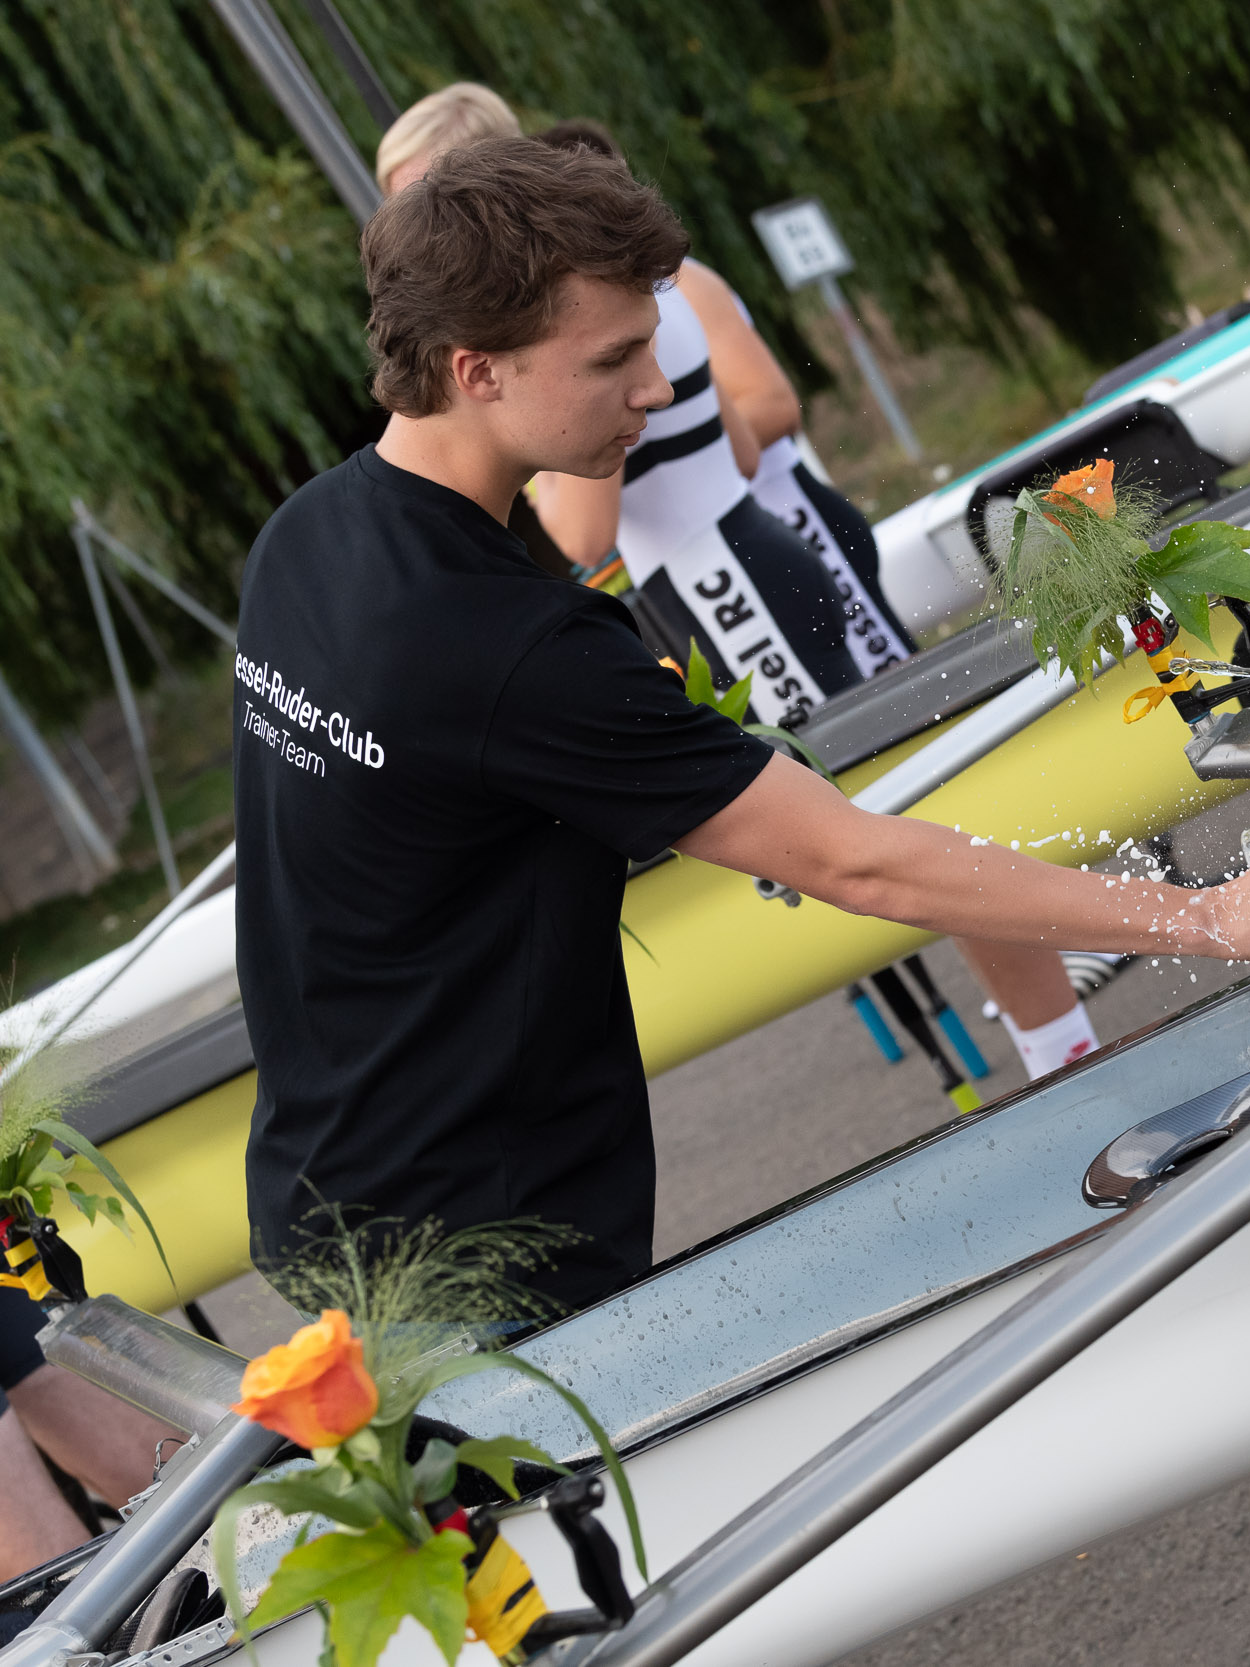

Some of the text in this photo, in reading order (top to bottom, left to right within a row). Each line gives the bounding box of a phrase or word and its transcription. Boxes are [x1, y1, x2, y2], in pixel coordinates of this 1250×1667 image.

[695, 569, 755, 633] RC
[235, 645, 385, 769] essel-Ruder-Club
[243, 701, 326, 778] Trainer-Team
